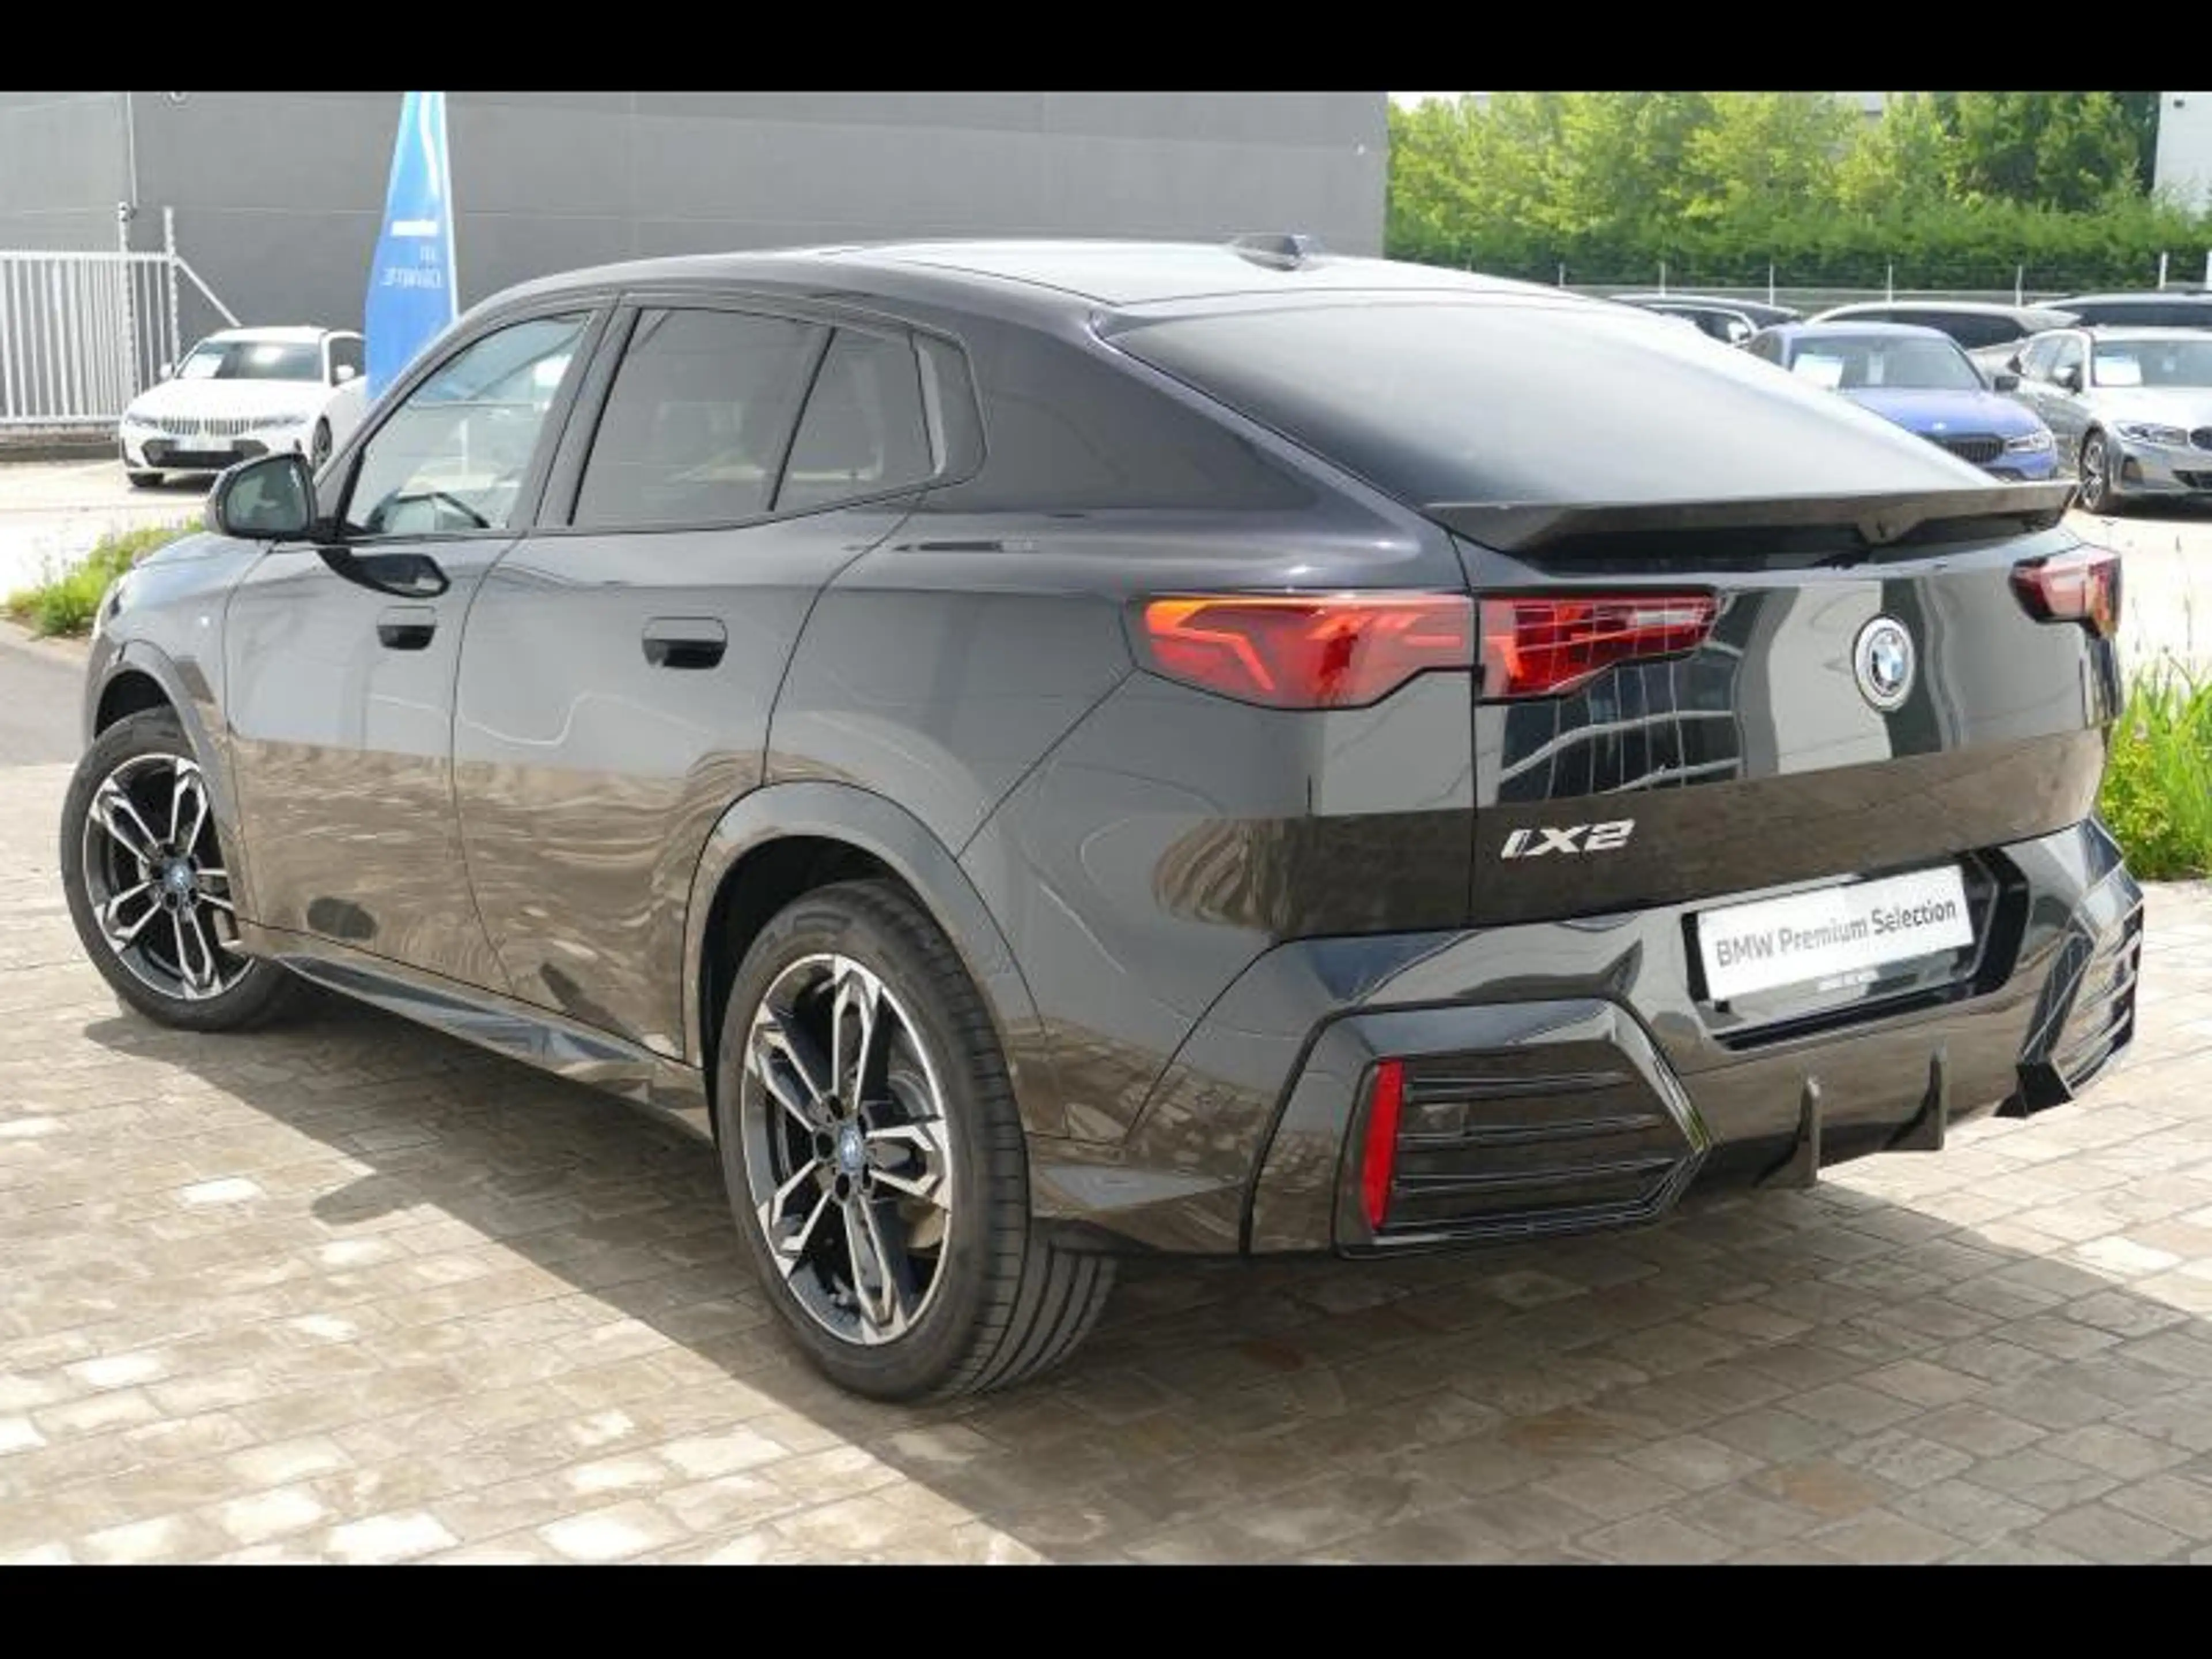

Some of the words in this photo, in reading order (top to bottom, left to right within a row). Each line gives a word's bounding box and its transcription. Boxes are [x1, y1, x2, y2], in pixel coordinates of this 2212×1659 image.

[1716, 933, 1774, 967] BMW
[1778, 917, 1869, 953] Premium
[1871, 899, 1957, 935] Selection
